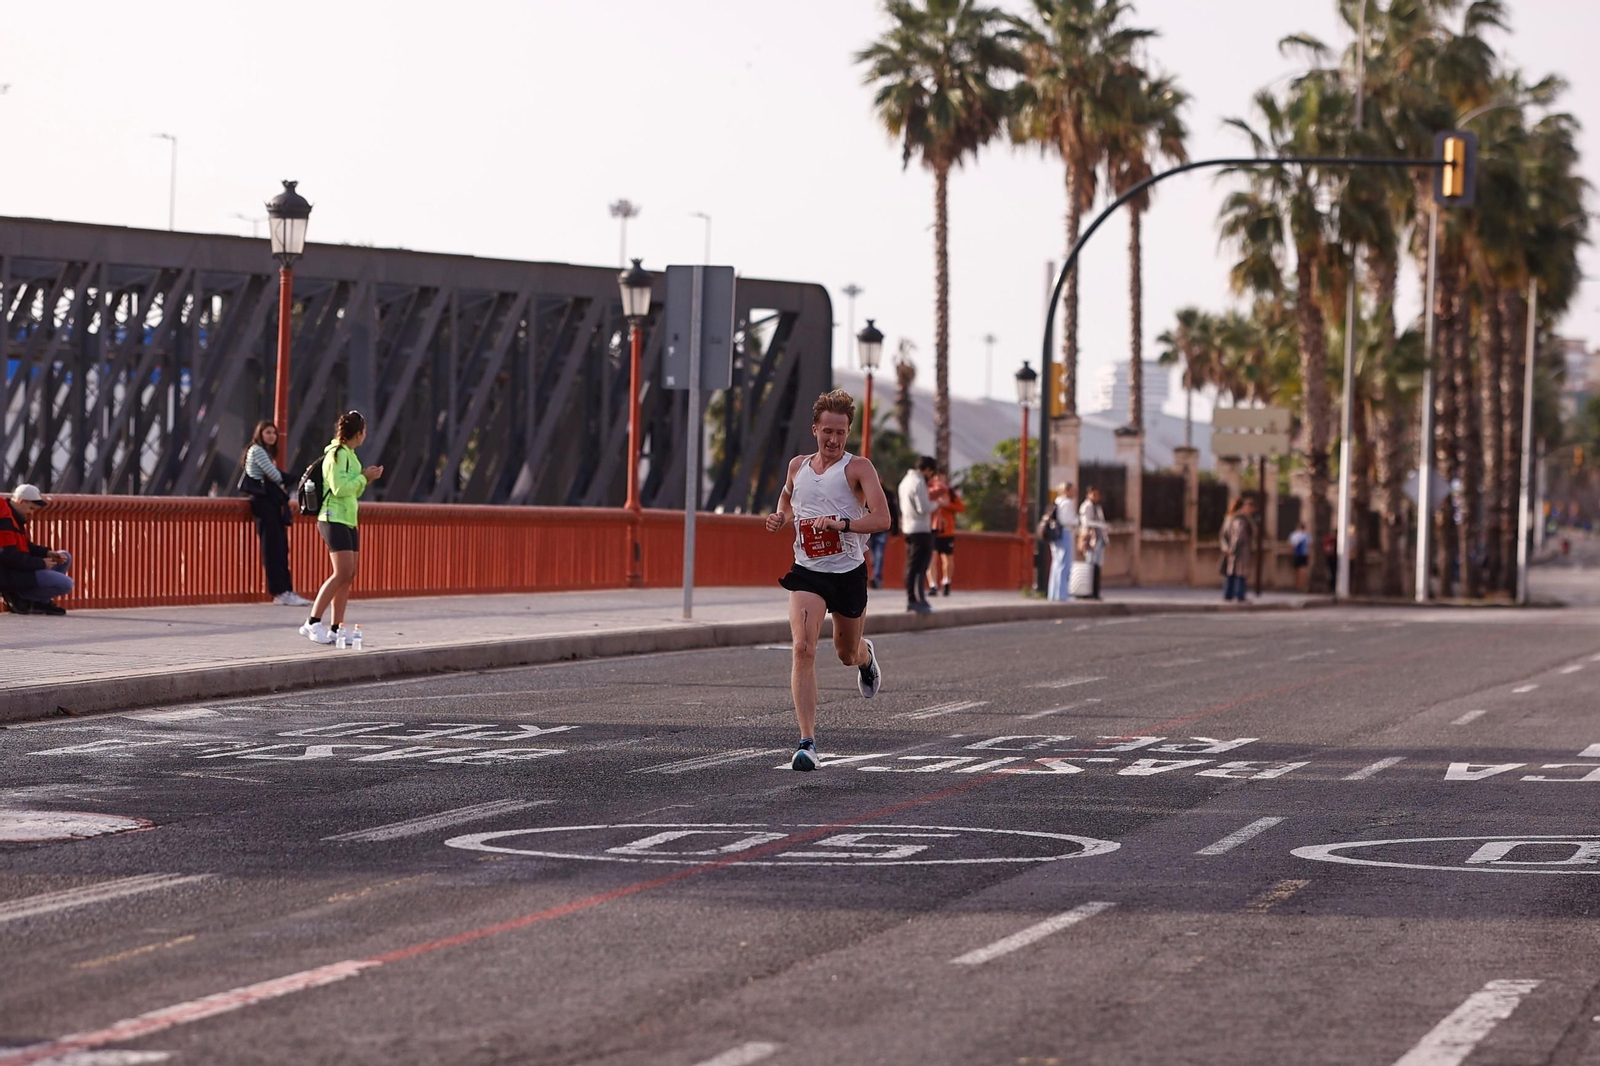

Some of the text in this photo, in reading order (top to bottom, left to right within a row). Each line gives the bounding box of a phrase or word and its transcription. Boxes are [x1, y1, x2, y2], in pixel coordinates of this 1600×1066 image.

[276, 721, 581, 741] RED
[961, 735, 1260, 754] RED
[773, 752, 1313, 779] BASICA
[604, 830, 962, 858] 50
